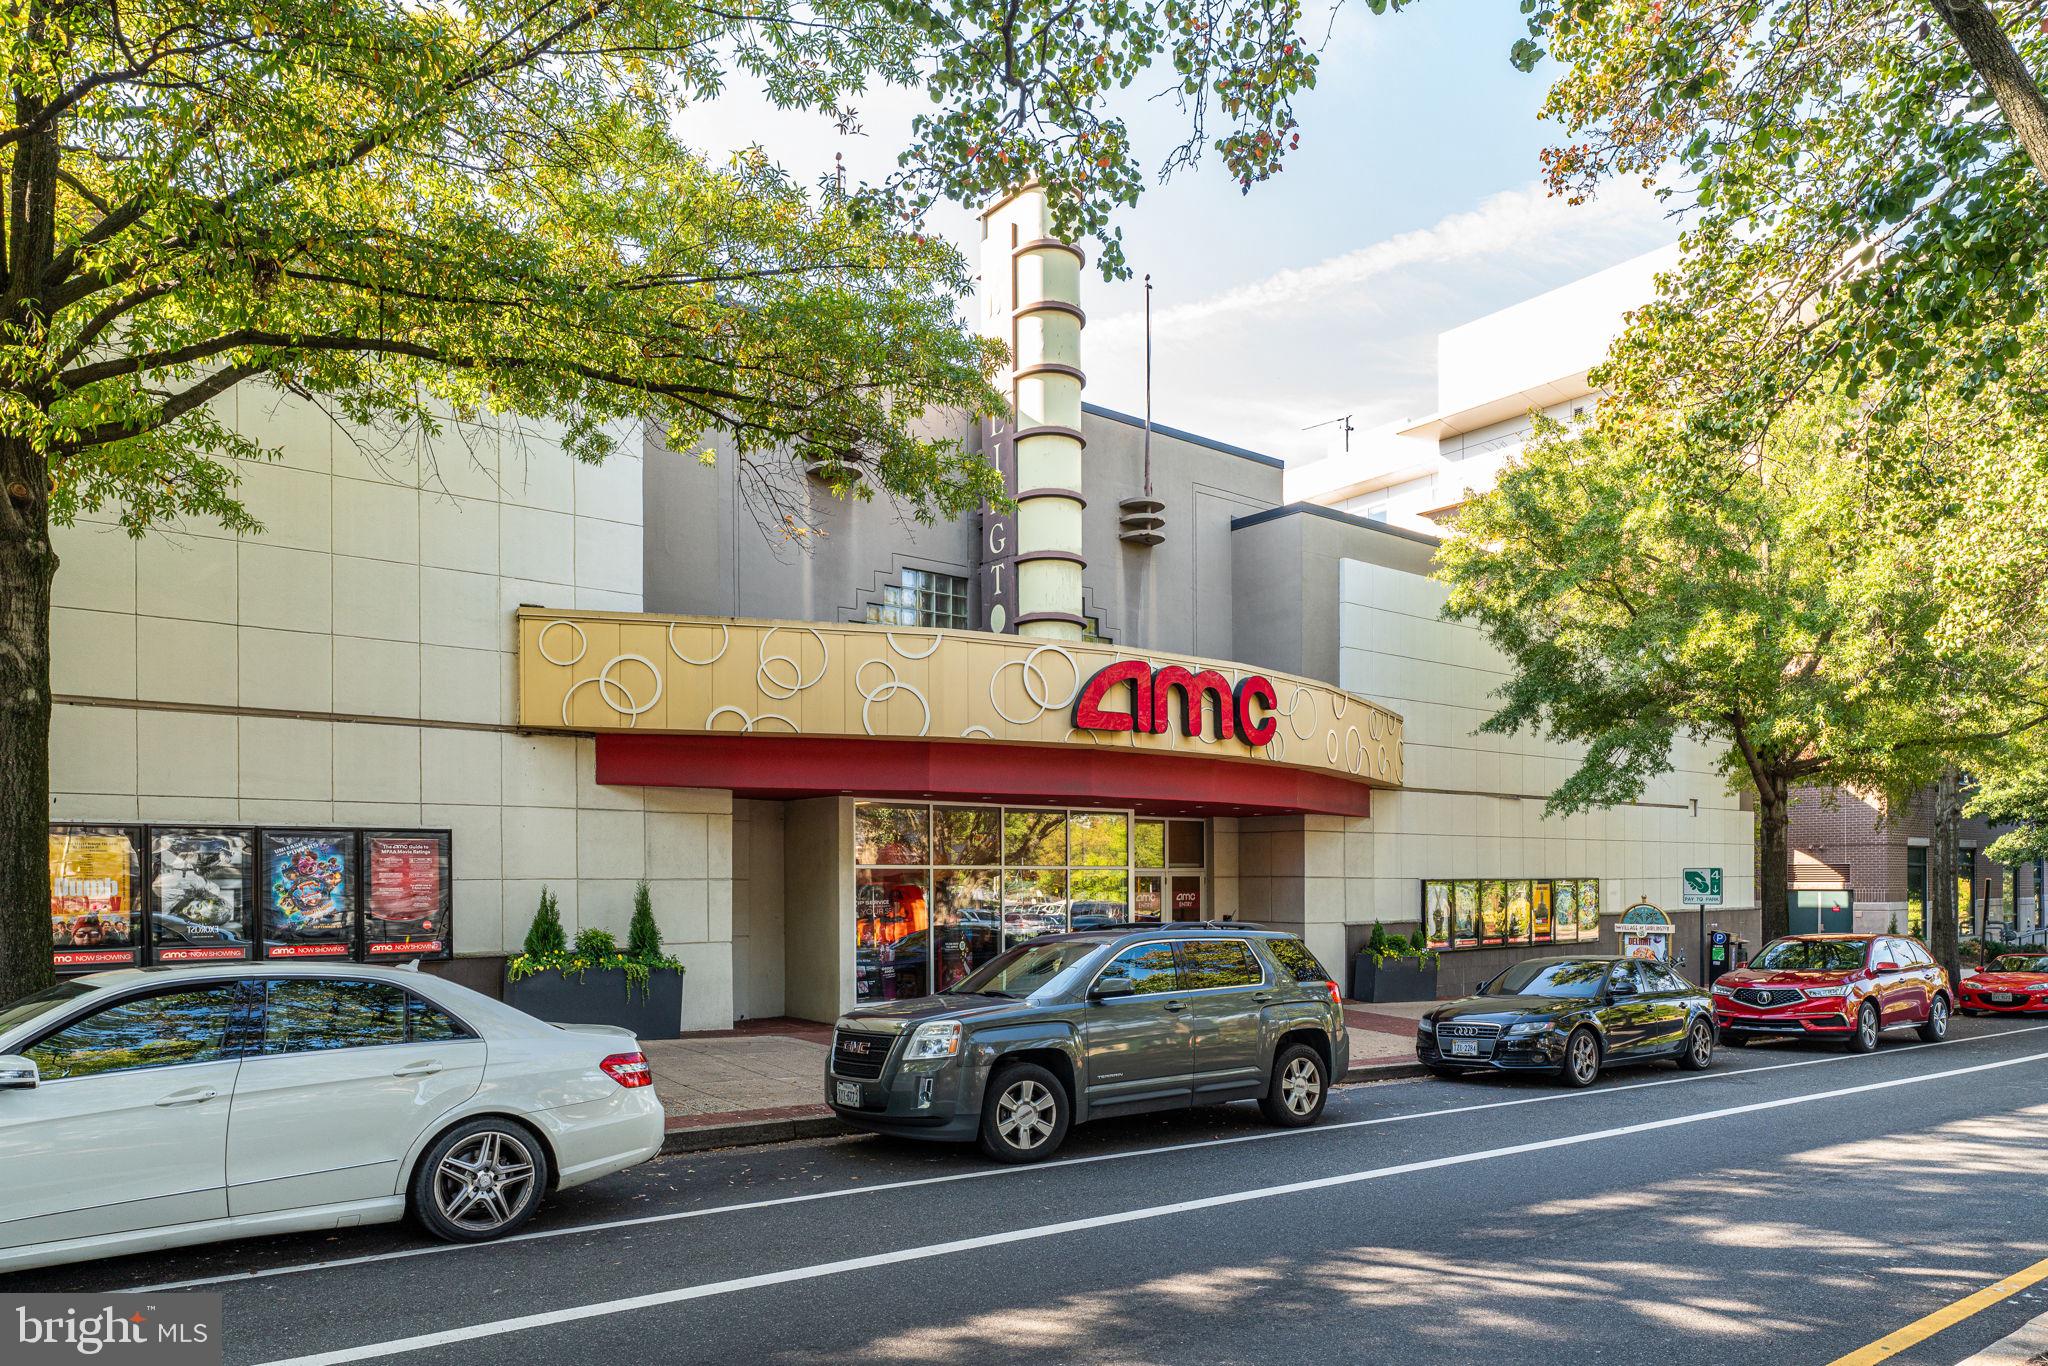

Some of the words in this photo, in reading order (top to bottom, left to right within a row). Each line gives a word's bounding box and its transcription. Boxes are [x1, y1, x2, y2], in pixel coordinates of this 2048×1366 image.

[1071, 660, 1278, 747] amc
[1711, 870, 1720, 880] 4
[1176, 892, 1196, 901] amc
[1716, 934, 1724, 942] P
[162, 951, 187, 959] amc
[272, 947, 295, 955] amc
[53, 953, 73, 963] mc
[843, 1040, 871, 1055] GMC
